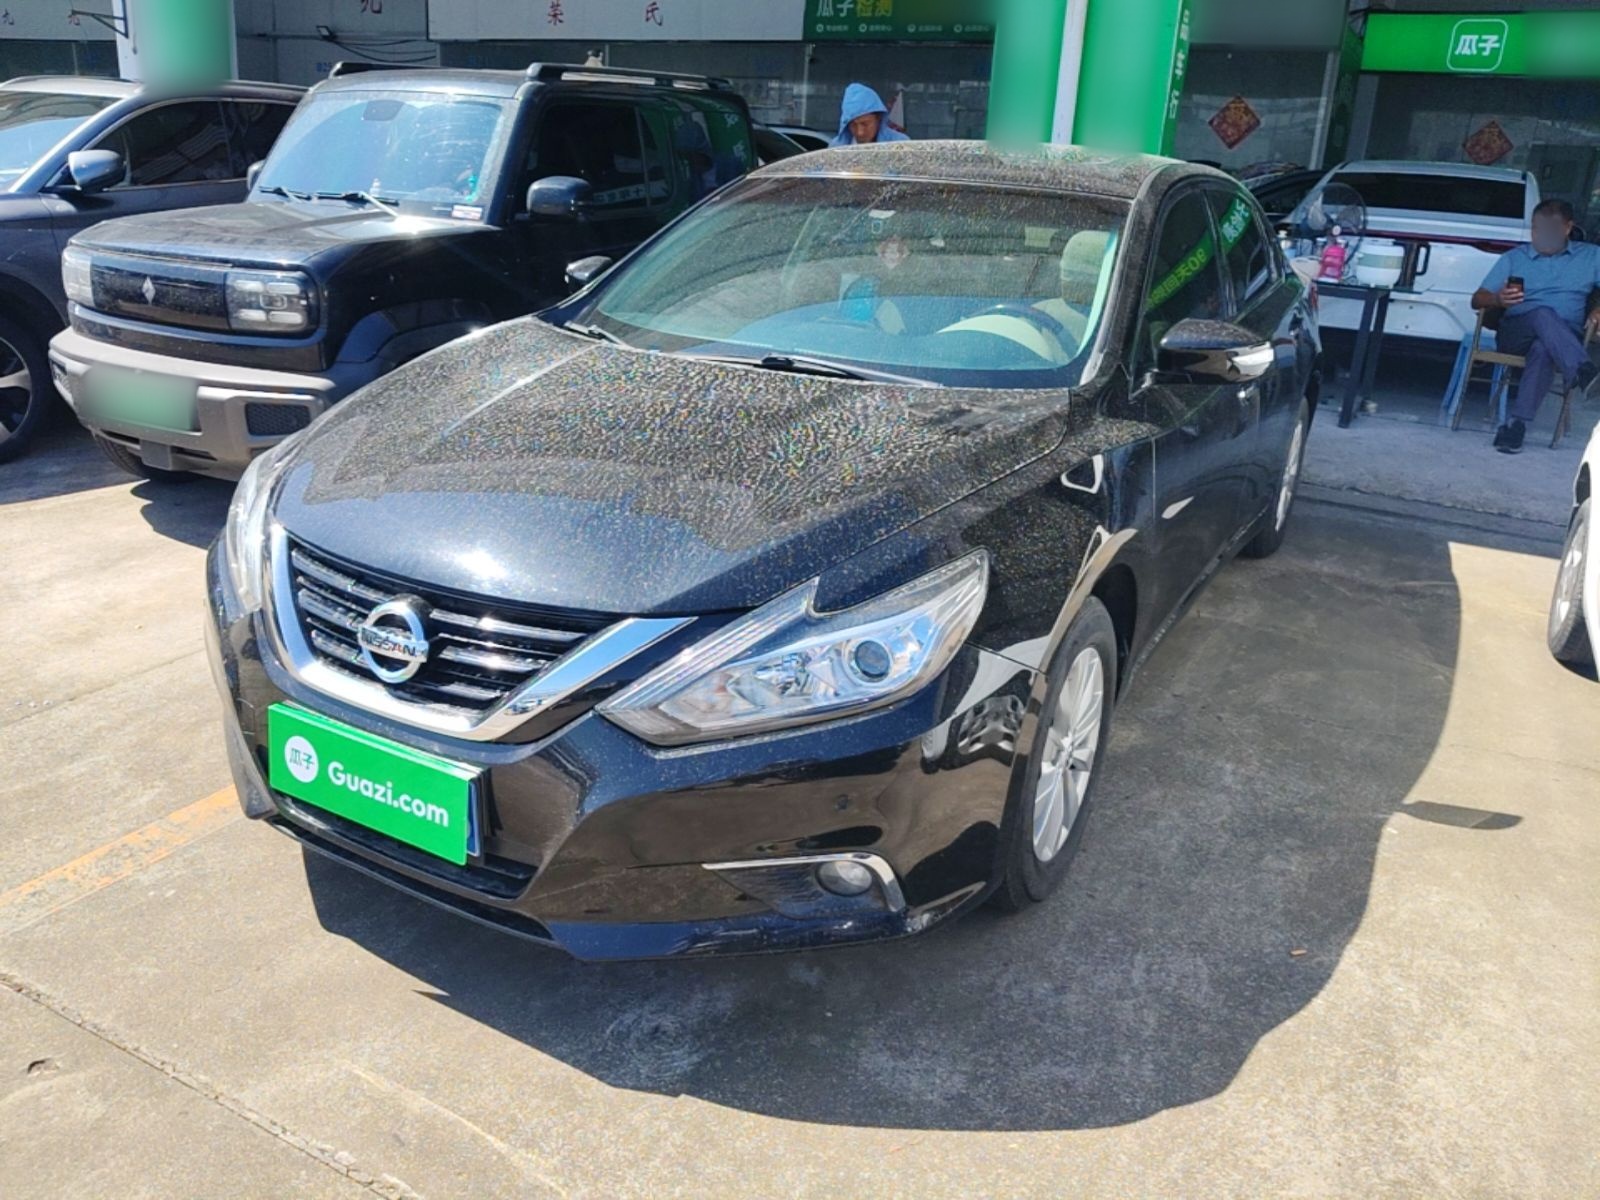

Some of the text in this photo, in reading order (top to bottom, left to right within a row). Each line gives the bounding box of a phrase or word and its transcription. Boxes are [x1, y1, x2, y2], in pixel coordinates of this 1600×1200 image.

[1454, 34, 1500, 56] 瓜子
[289, 747, 315, 770] 瓜子
[327, 761, 449, 828] Guazi.com
